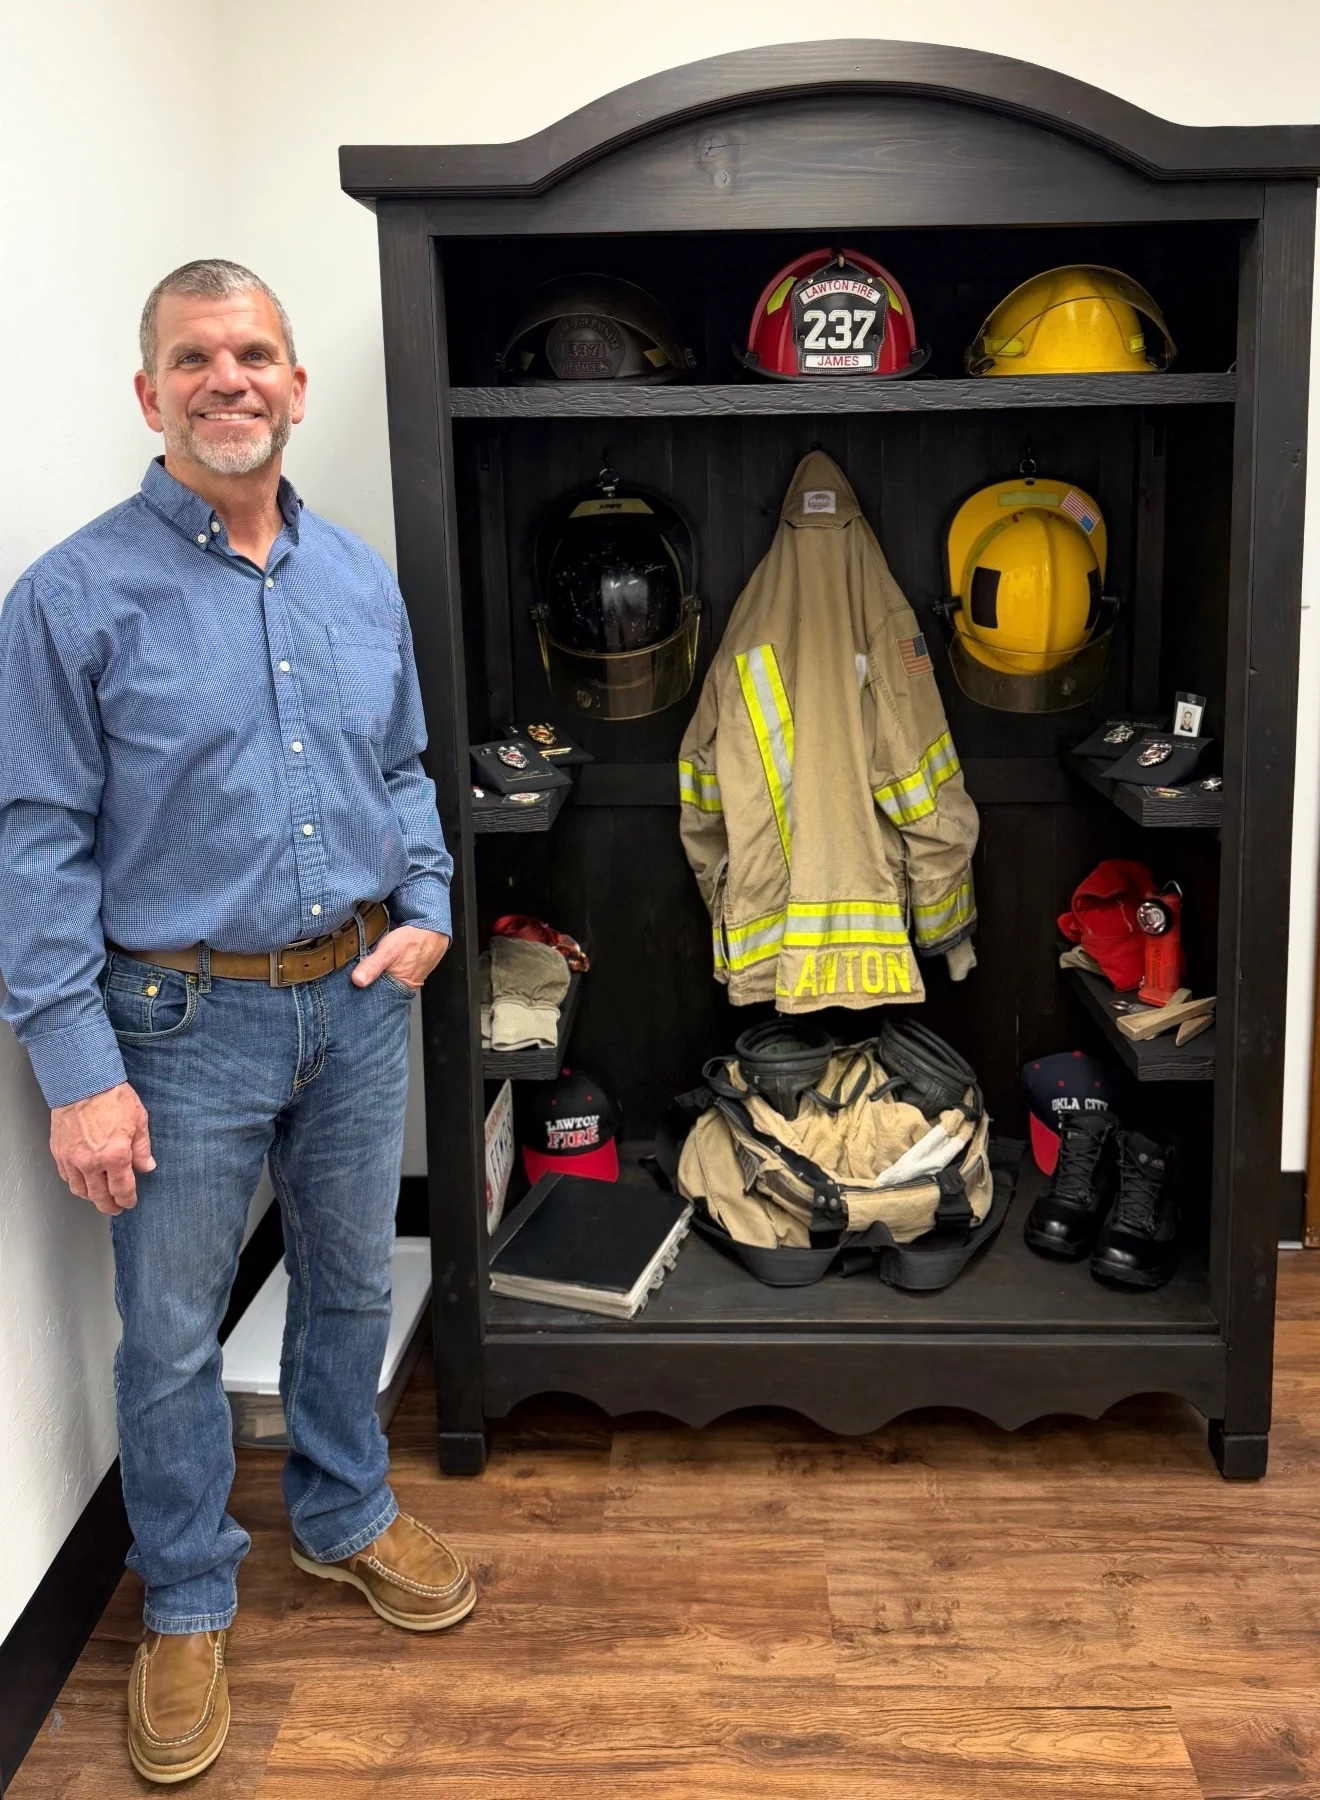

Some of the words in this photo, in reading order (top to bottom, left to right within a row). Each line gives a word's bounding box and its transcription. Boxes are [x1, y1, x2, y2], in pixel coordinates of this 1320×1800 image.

[804, 280, 849, 299] LAWTON
[851, 281, 875, 299] FIRE
[803, 309, 876, 350] 237
[817, 355, 860, 366] JAMES
[1051, 1097, 1080, 1112] OKLA
[1084, 1097, 1108, 1112] CITY
[545, 1115, 600, 1131] LAWTON
[547, 1125, 600, 1149] FIRE
